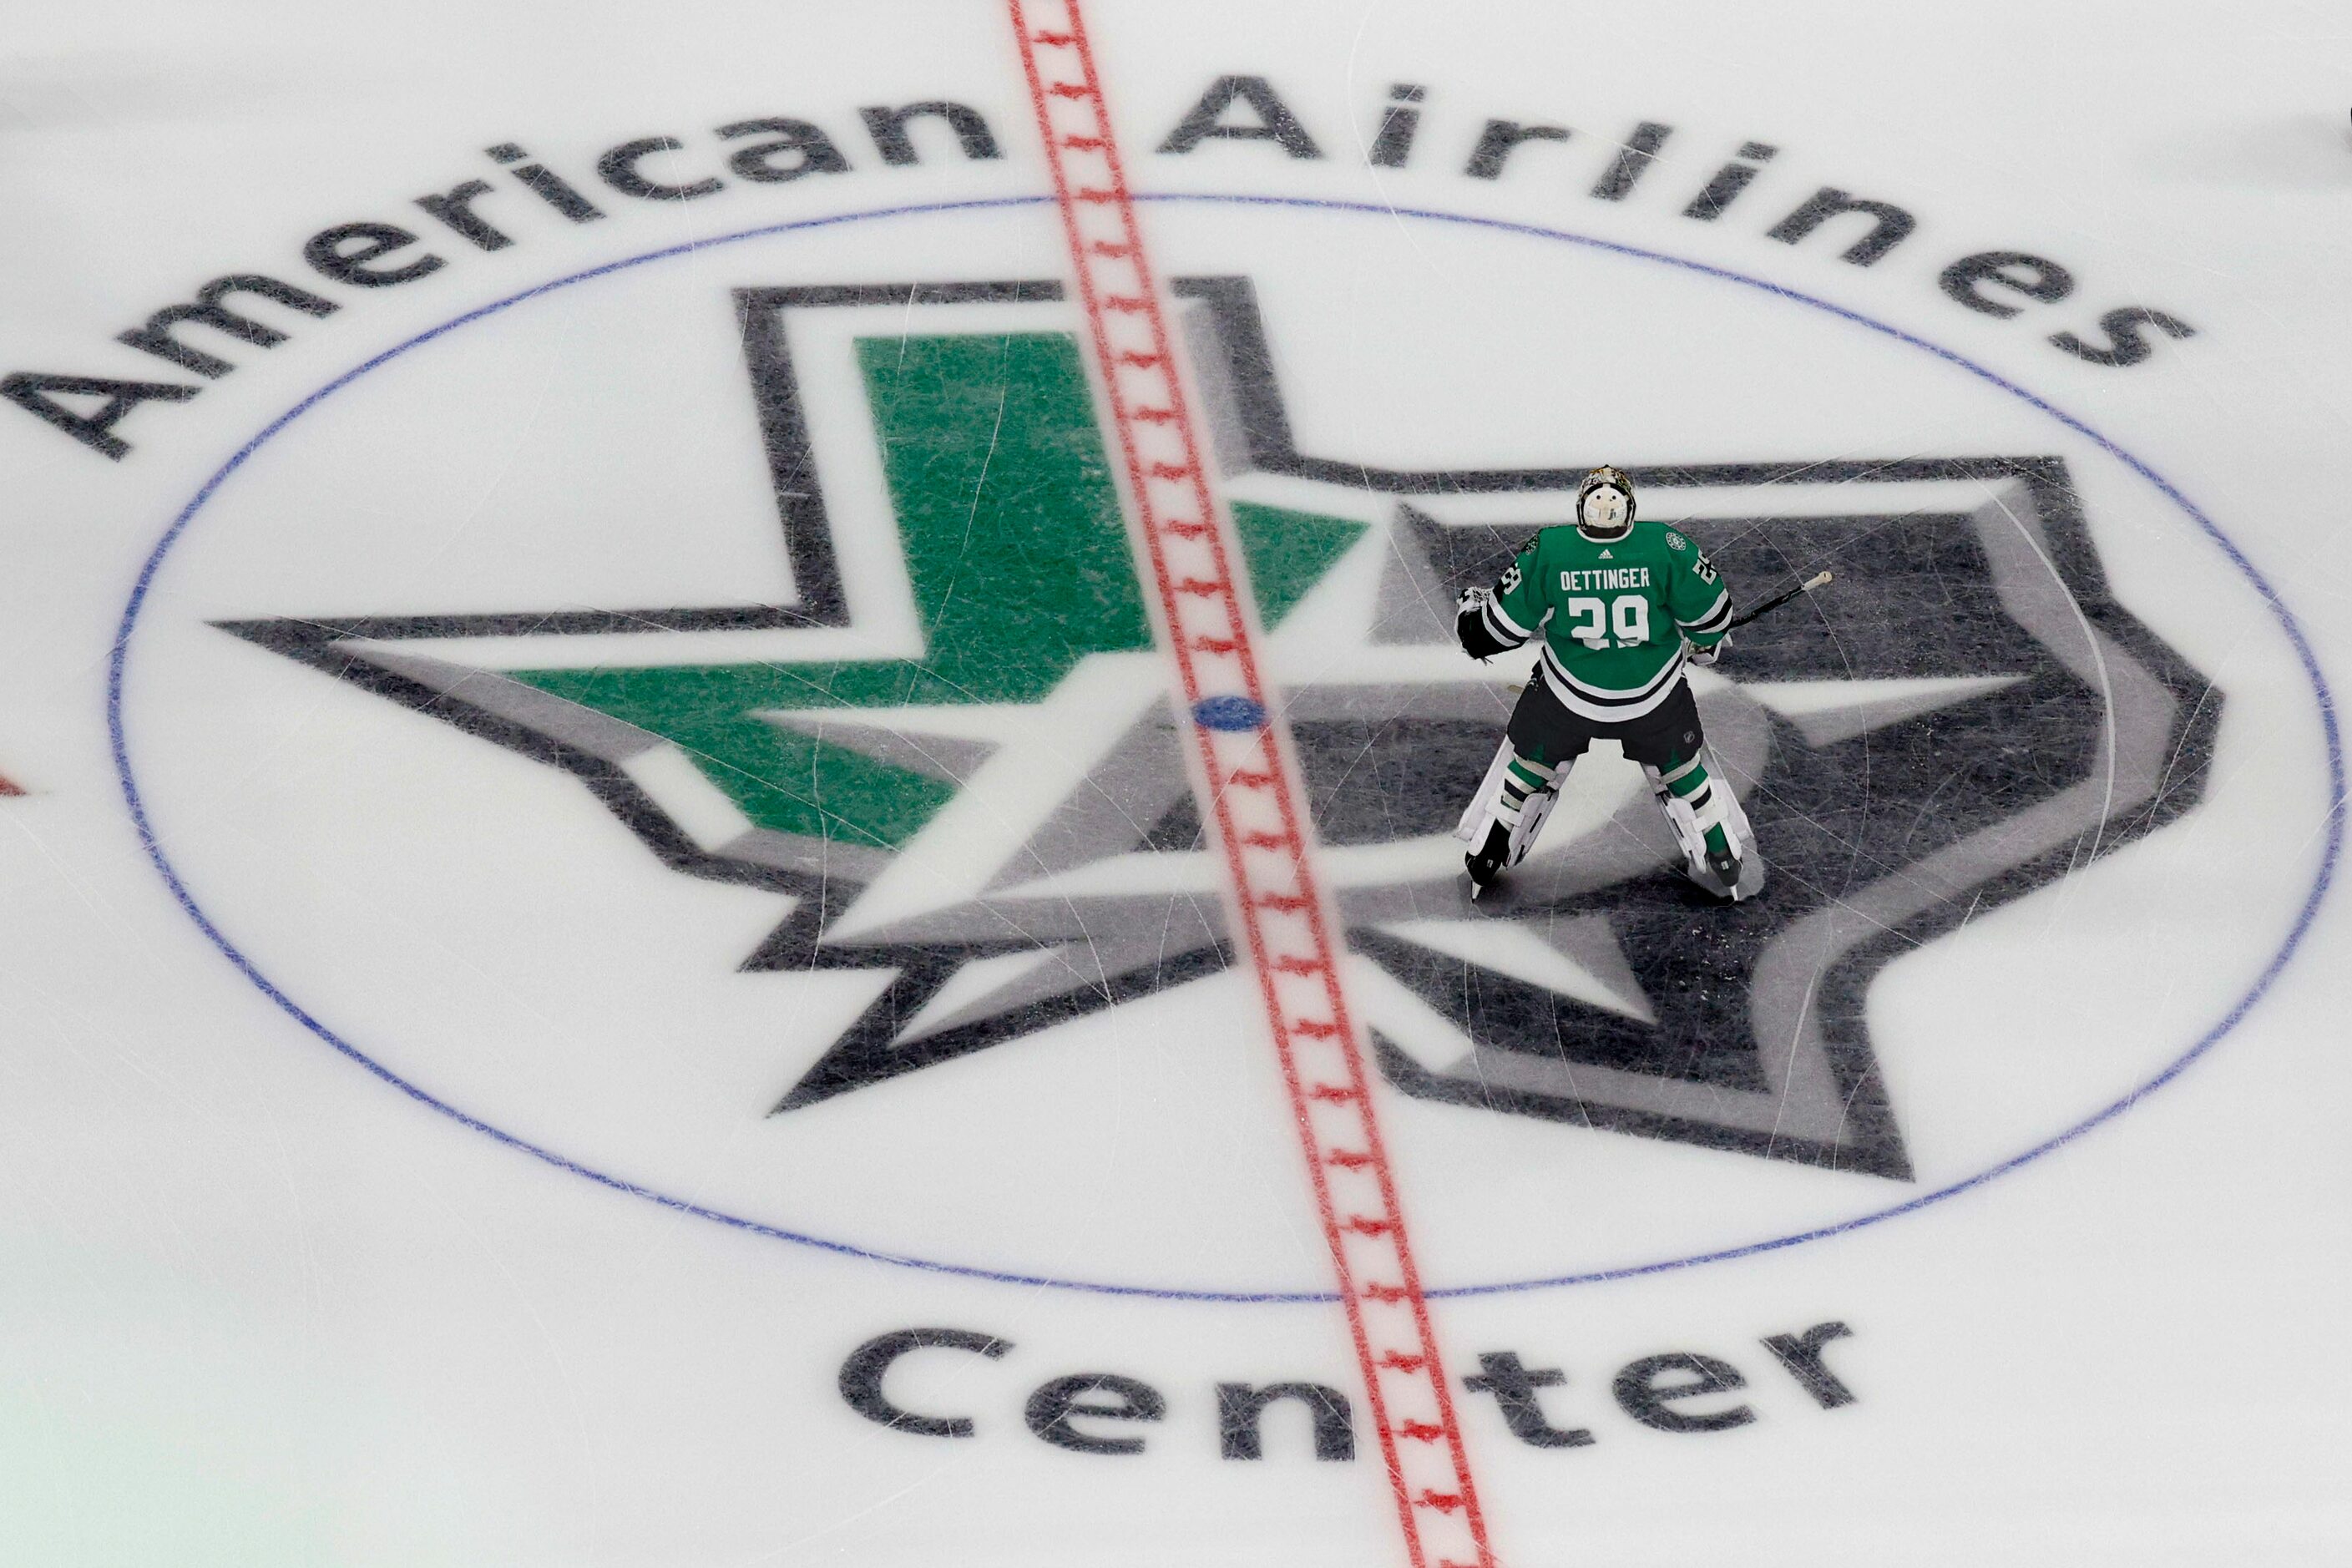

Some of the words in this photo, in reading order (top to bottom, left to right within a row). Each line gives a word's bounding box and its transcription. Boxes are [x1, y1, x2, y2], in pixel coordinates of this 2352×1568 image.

[0, 99, 1007, 463] American
[1154, 74, 2198, 368] Airlines
[1560, 567, 1651, 591] OETTINGER
[1568, 594, 1650, 650] 29
[837, 1321, 1856, 1463] Center
